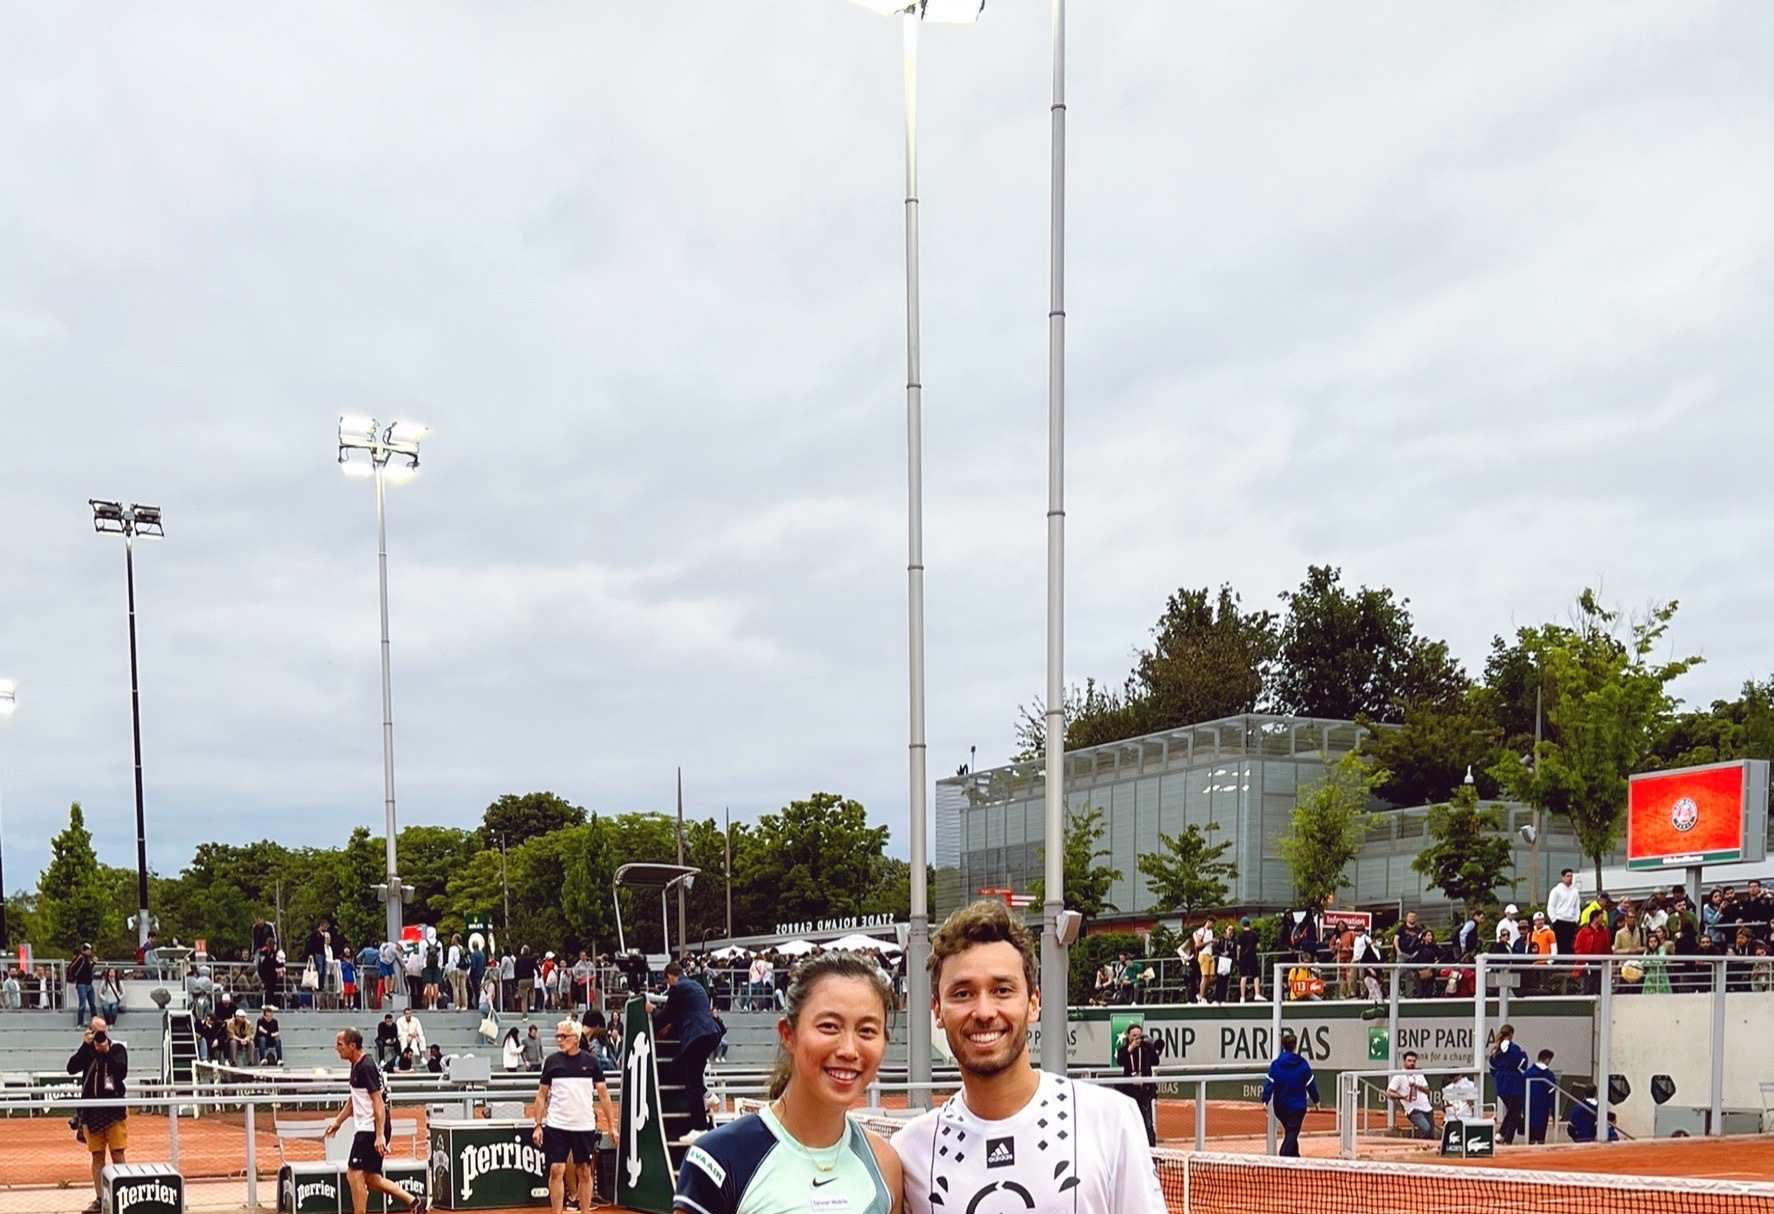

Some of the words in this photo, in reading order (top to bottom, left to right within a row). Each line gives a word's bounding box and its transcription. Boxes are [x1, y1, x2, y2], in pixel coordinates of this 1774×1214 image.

[1435, 1028, 1495, 1048] PARIA
[459, 1134, 546, 1201] perrier
[988, 1154, 1013, 1163] adidas
[297, 1180, 336, 1209] perrier
